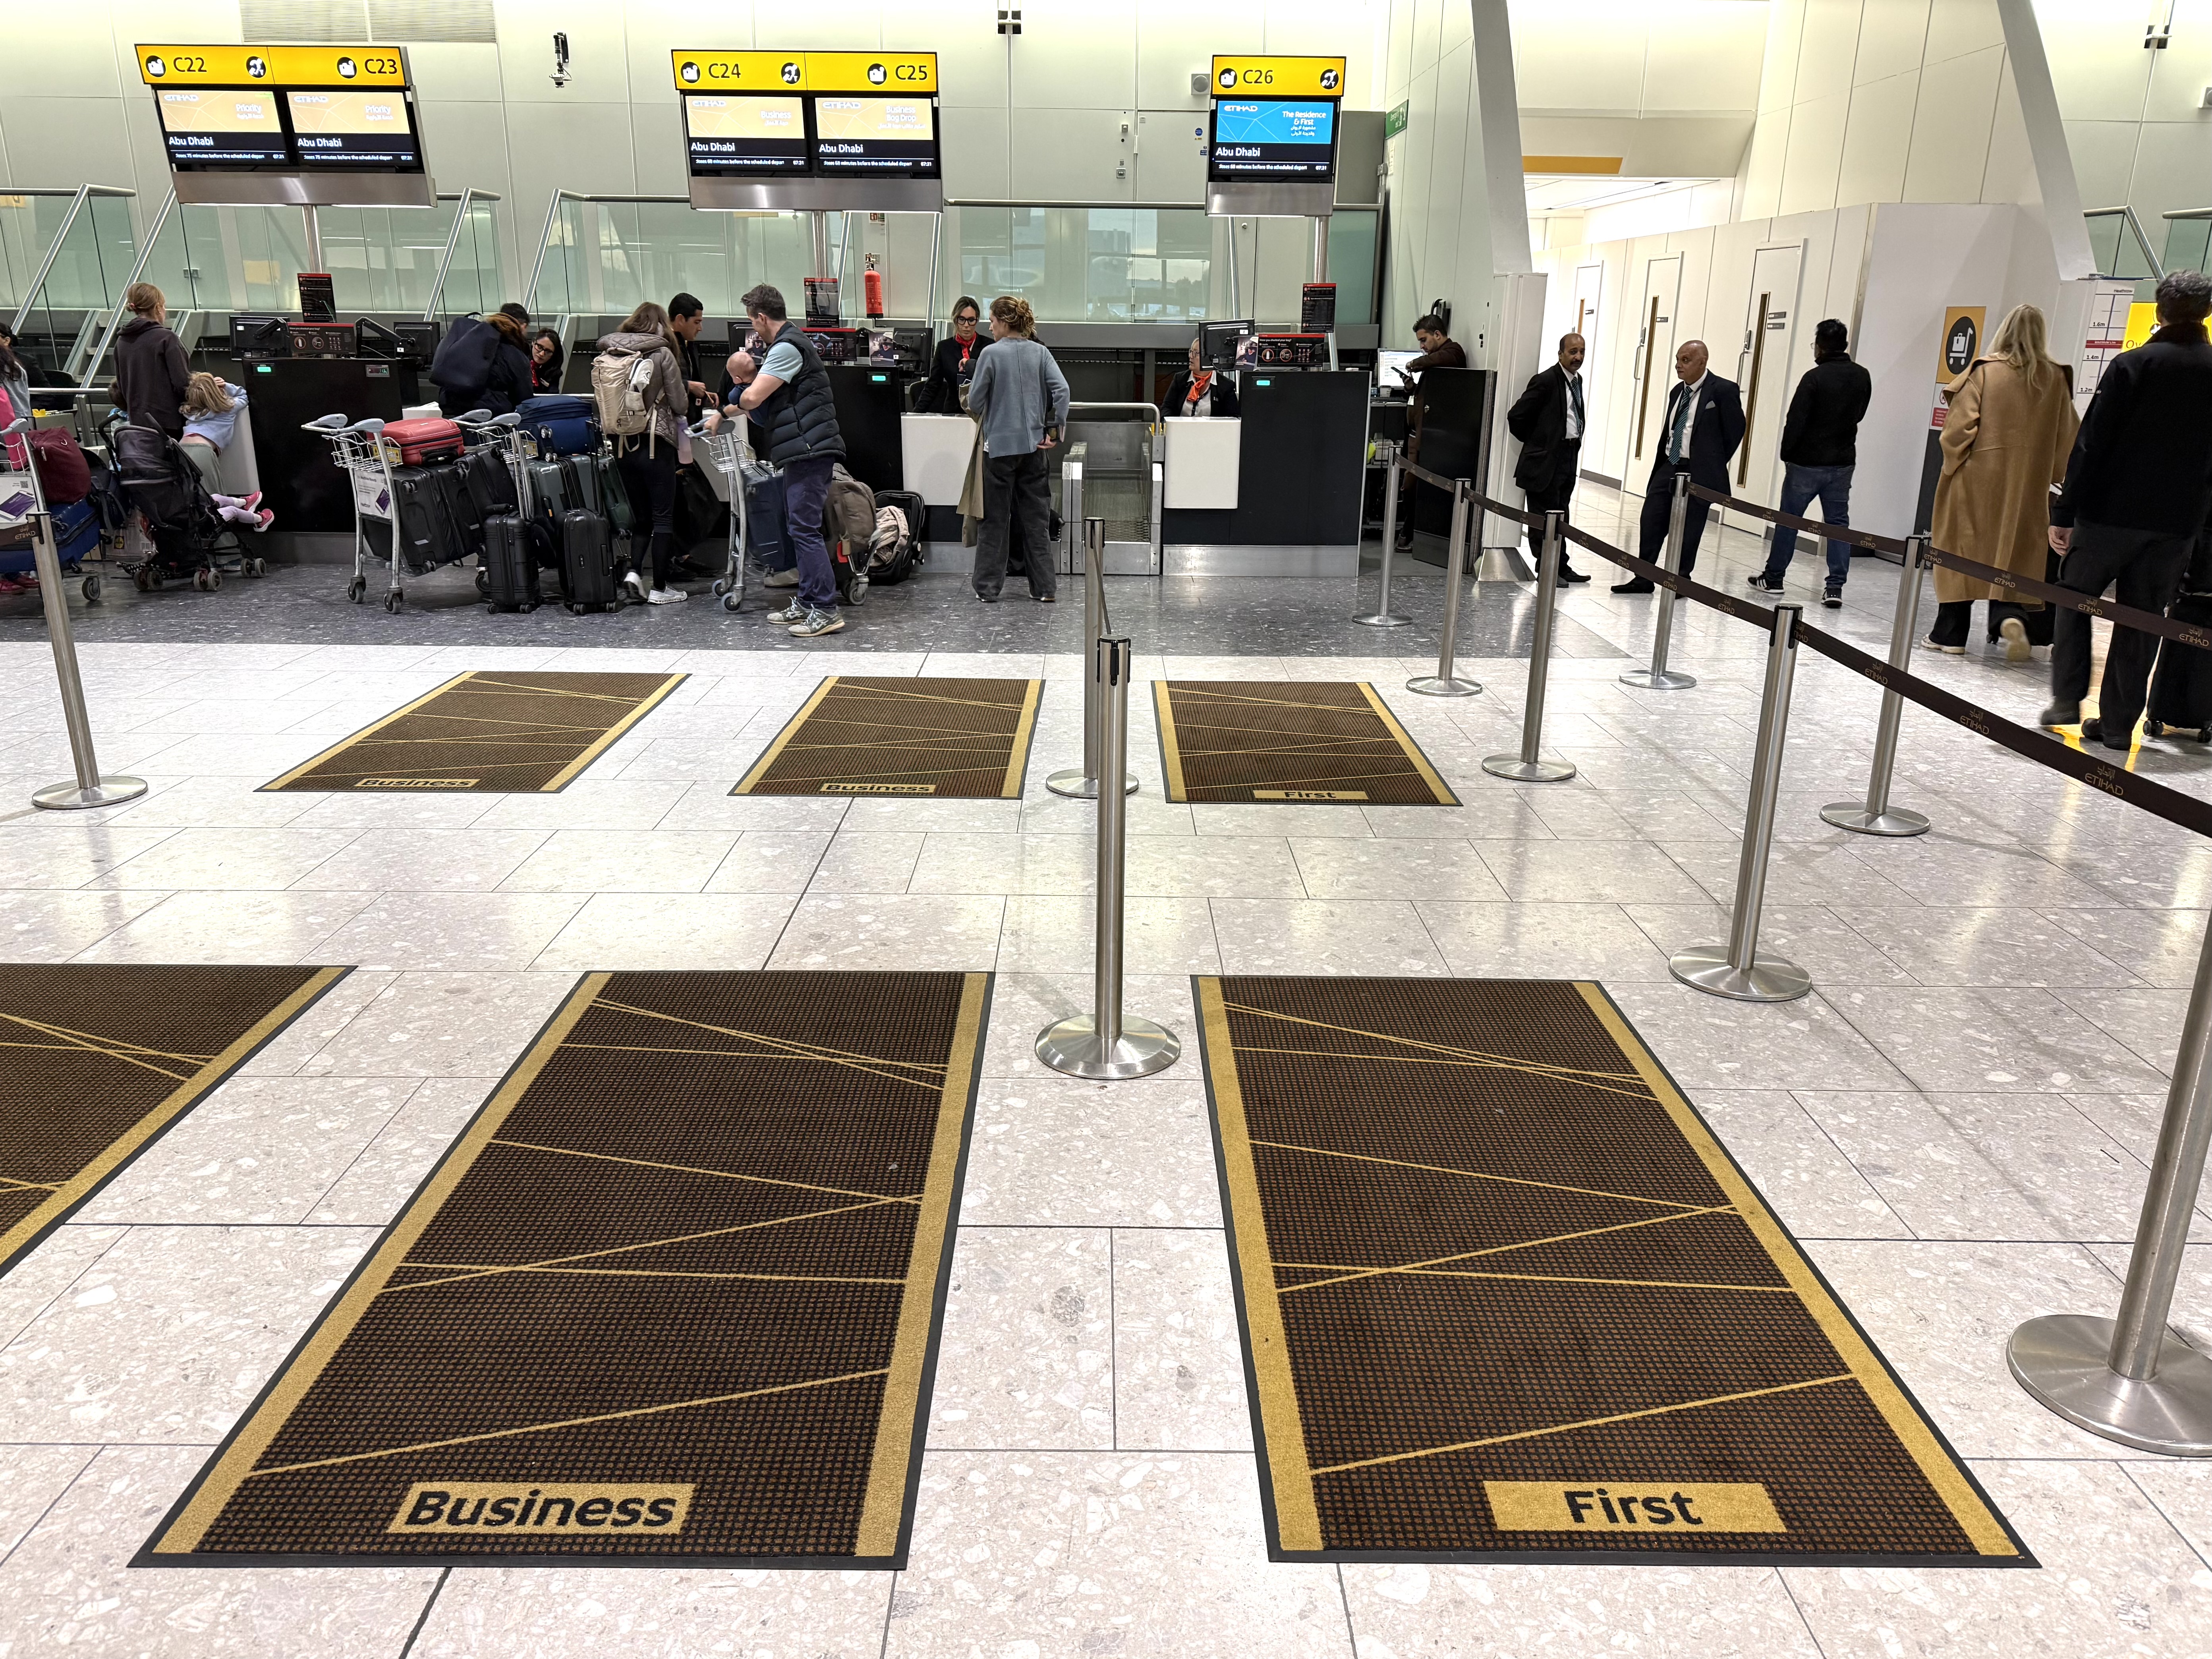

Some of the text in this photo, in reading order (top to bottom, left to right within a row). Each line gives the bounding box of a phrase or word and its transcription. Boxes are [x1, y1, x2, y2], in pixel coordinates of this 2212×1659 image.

[174, 57, 207, 72] C22
[365, 59, 397, 74] C23
[709, 63, 741, 78] C24
[895, 65, 927, 80] C25
[1243, 70, 1273, 84] C26
[236, 104, 262, 113] Priority
[365, 105, 391, 114] Priority
[187, 137, 213, 146] Dhabi
[317, 138, 342, 147] Dhabi
[691, 142, 735, 151] Abu Dhabi
[819, 144, 864, 153] Abu Dhabi
[1215, 147, 1233, 156] Abu
[1236, 147, 1260, 156] Dhabi
[15, 531, 35, 539] ETIHAD
[1924, 554, 1942, 563] ETIHAD
[1663, 580, 1677, 591] ETIHAD
[1994, 578, 2015, 588] ETIHAD
[1718, 603, 1735, 615] ETIHAD
[2078, 603, 2102, 615] ETIHAD
[1794, 630, 1808, 643] TIHAD
[2179, 633, 2209, 646] ETIHAD
[1865, 668, 1888, 685] ETIHAD
[1960, 715, 1989, 735] ETIHAD
[825, 784, 930, 793] Business
[2085, 773, 2123, 795] ETIHAD
[404, 1488, 677, 1527] Business
[1564, 1487, 1704, 1525] First
